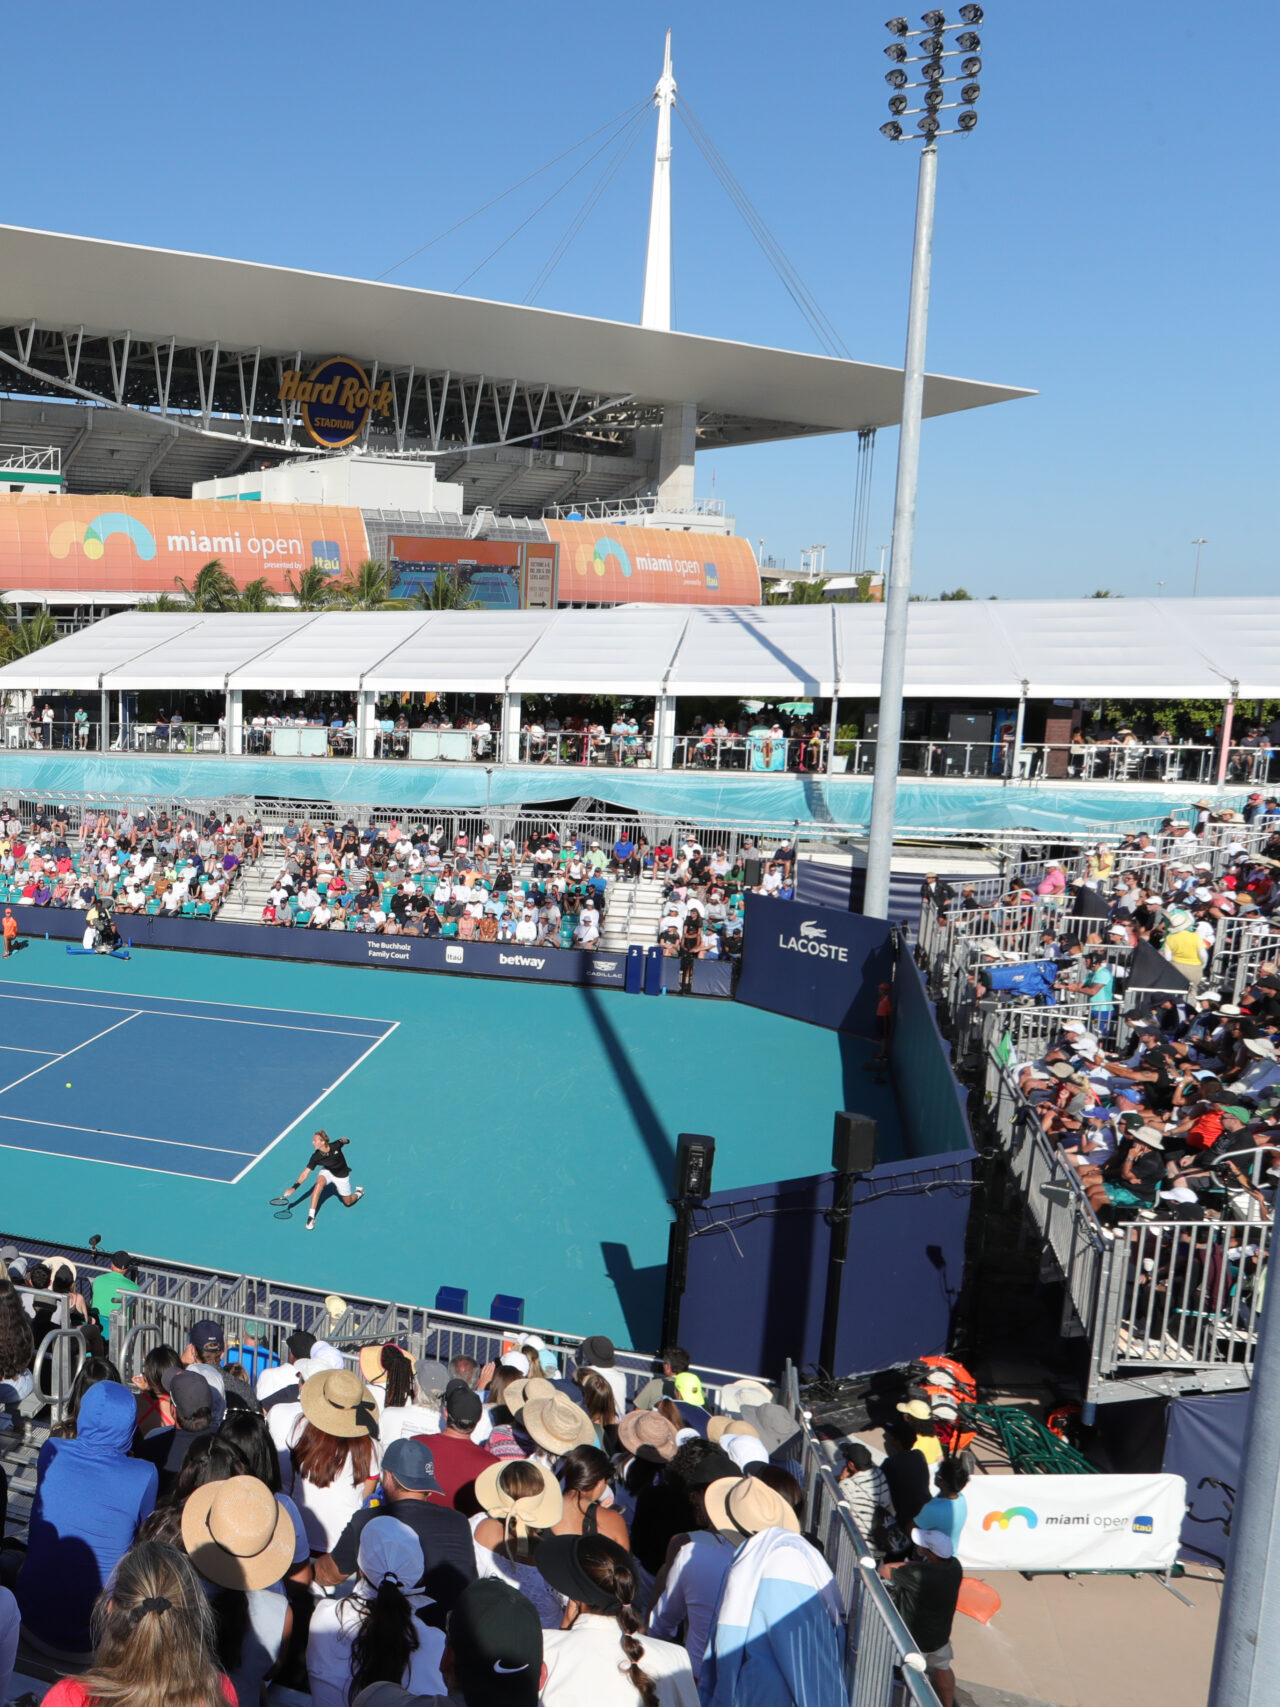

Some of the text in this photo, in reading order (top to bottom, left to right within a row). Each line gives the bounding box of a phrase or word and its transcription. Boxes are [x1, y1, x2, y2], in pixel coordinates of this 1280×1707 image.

[278, 369, 393, 416] Hard Rock
[314, 417, 355, 430] STADIUM
[167, 529, 302, 559] miami open
[314, 557, 340, 571] Itaú
[636, 552, 700, 579] miami open
[380, 941, 411, 951] Buchholz
[632, 949, 638, 957] 2
[779, 933, 849, 962] LACOSTE
[368, 950, 409, 960] Family Court
[447, 953, 463, 961] Itaú
[499, 953, 546, 970] betway
[586, 971, 623, 979] CADILLAC
[1045, 1513, 1129, 1528] miami open
